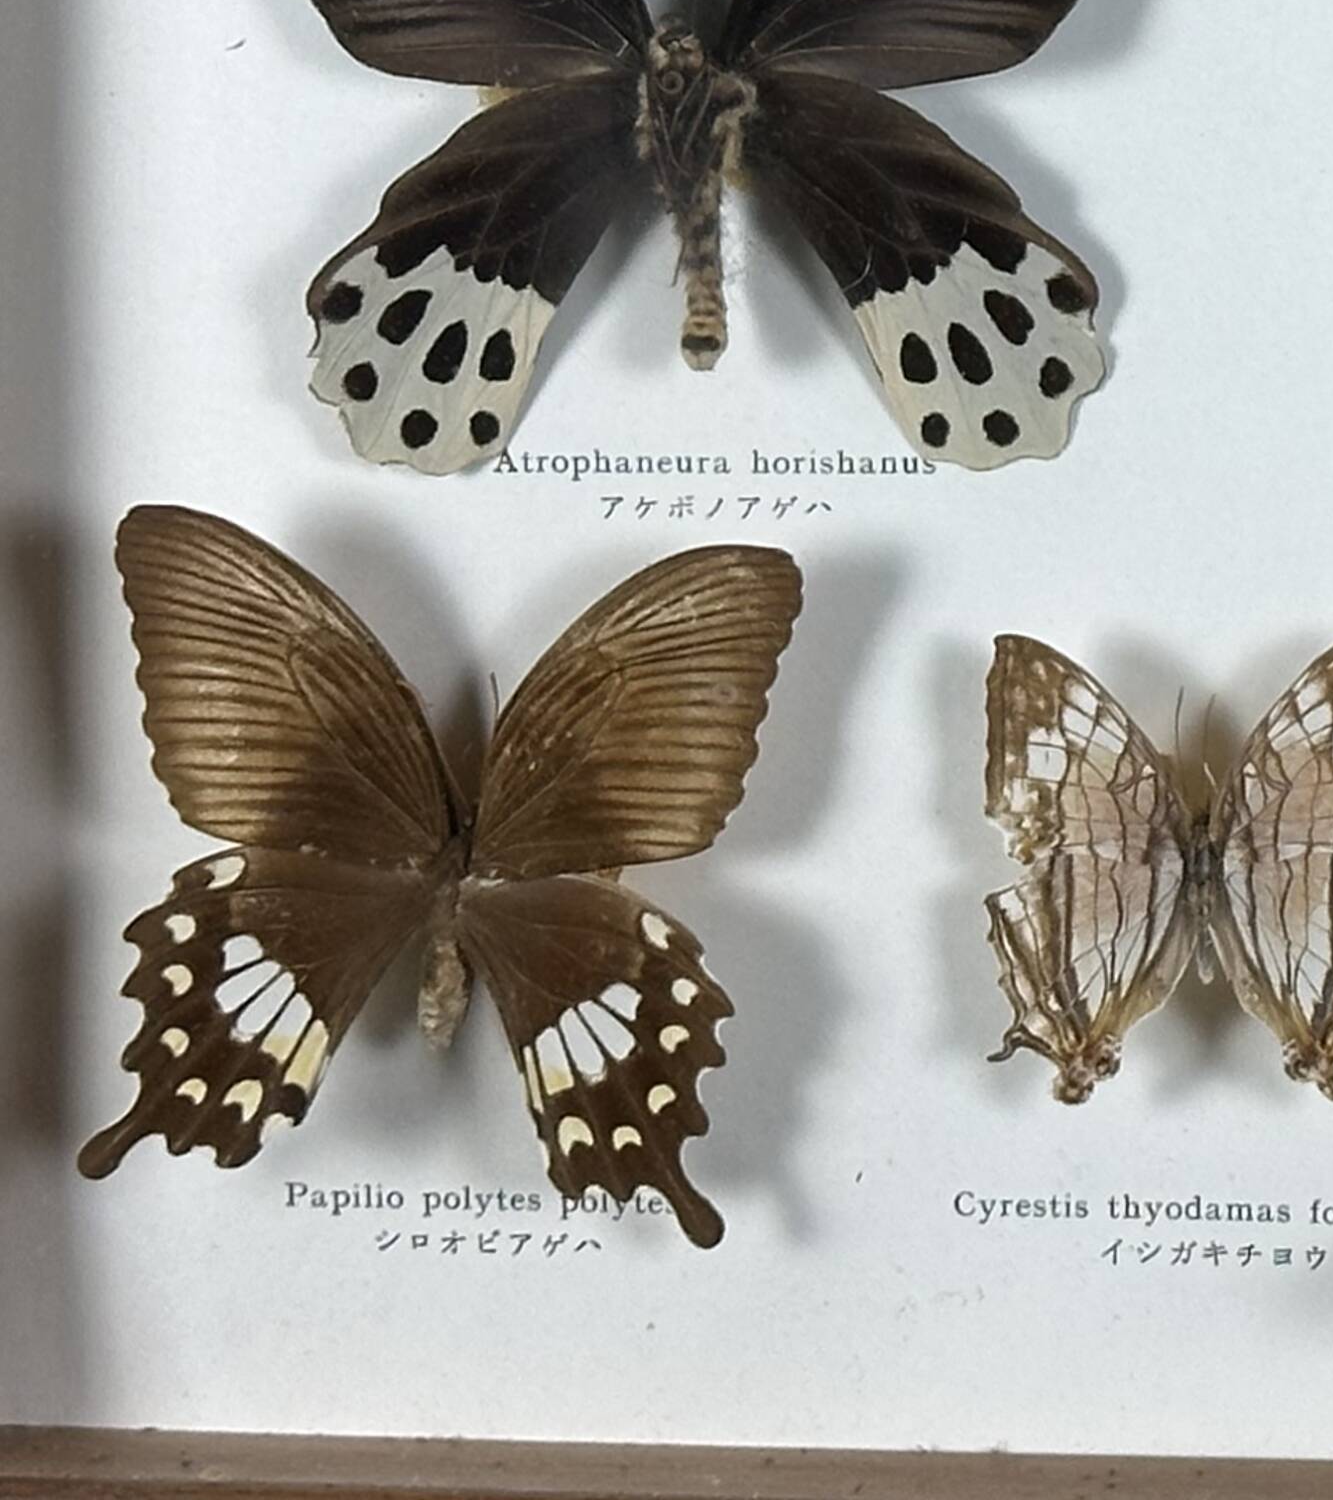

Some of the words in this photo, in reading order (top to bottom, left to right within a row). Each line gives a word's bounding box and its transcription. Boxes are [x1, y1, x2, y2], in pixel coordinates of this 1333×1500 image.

[492, 448, 734, 482] Atrophaneura
[751, 448, 937, 476] horishanus
[284, 1181, 405, 1217] Papilio
[421, 1184, 542, 1220] polytes
[953, 1190, 1090, 1223] Cyrestis
[1107, 1192, 1292, 1228] thyodamas
